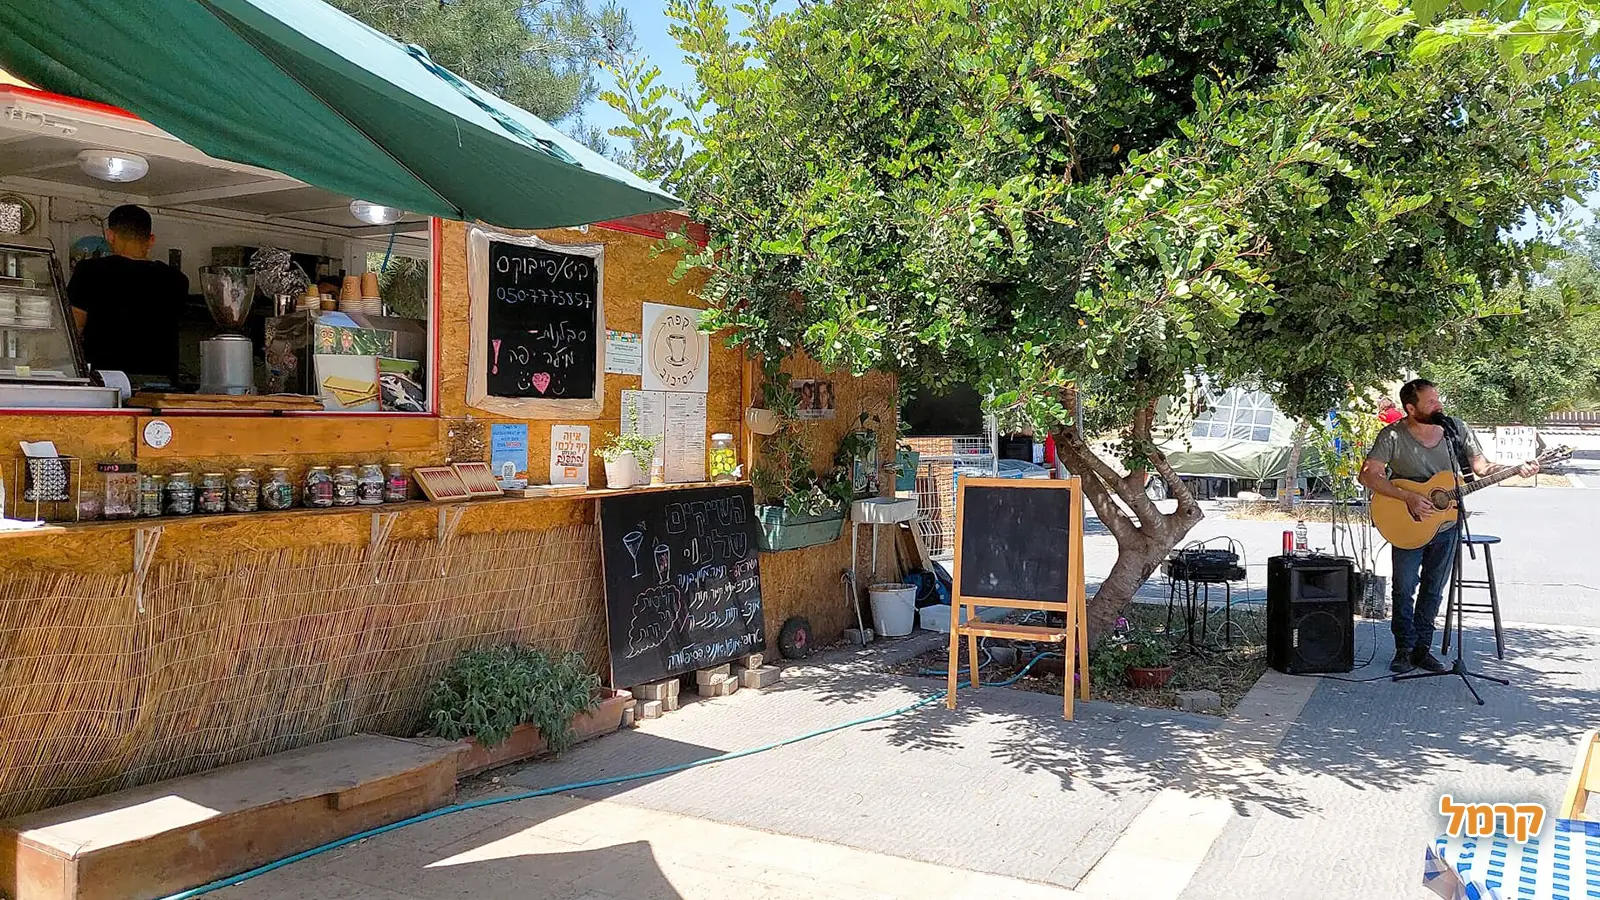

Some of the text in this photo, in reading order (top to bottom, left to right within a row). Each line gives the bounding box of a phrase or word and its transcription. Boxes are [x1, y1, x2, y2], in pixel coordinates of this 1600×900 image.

[667, 315, 690, 330] קפה
[508, 346, 537, 365] יפה
[542, 346, 574, 367] מילה
[659, 368, 694, 387] בסיבוב
[563, 431, 583, 441] איזה
